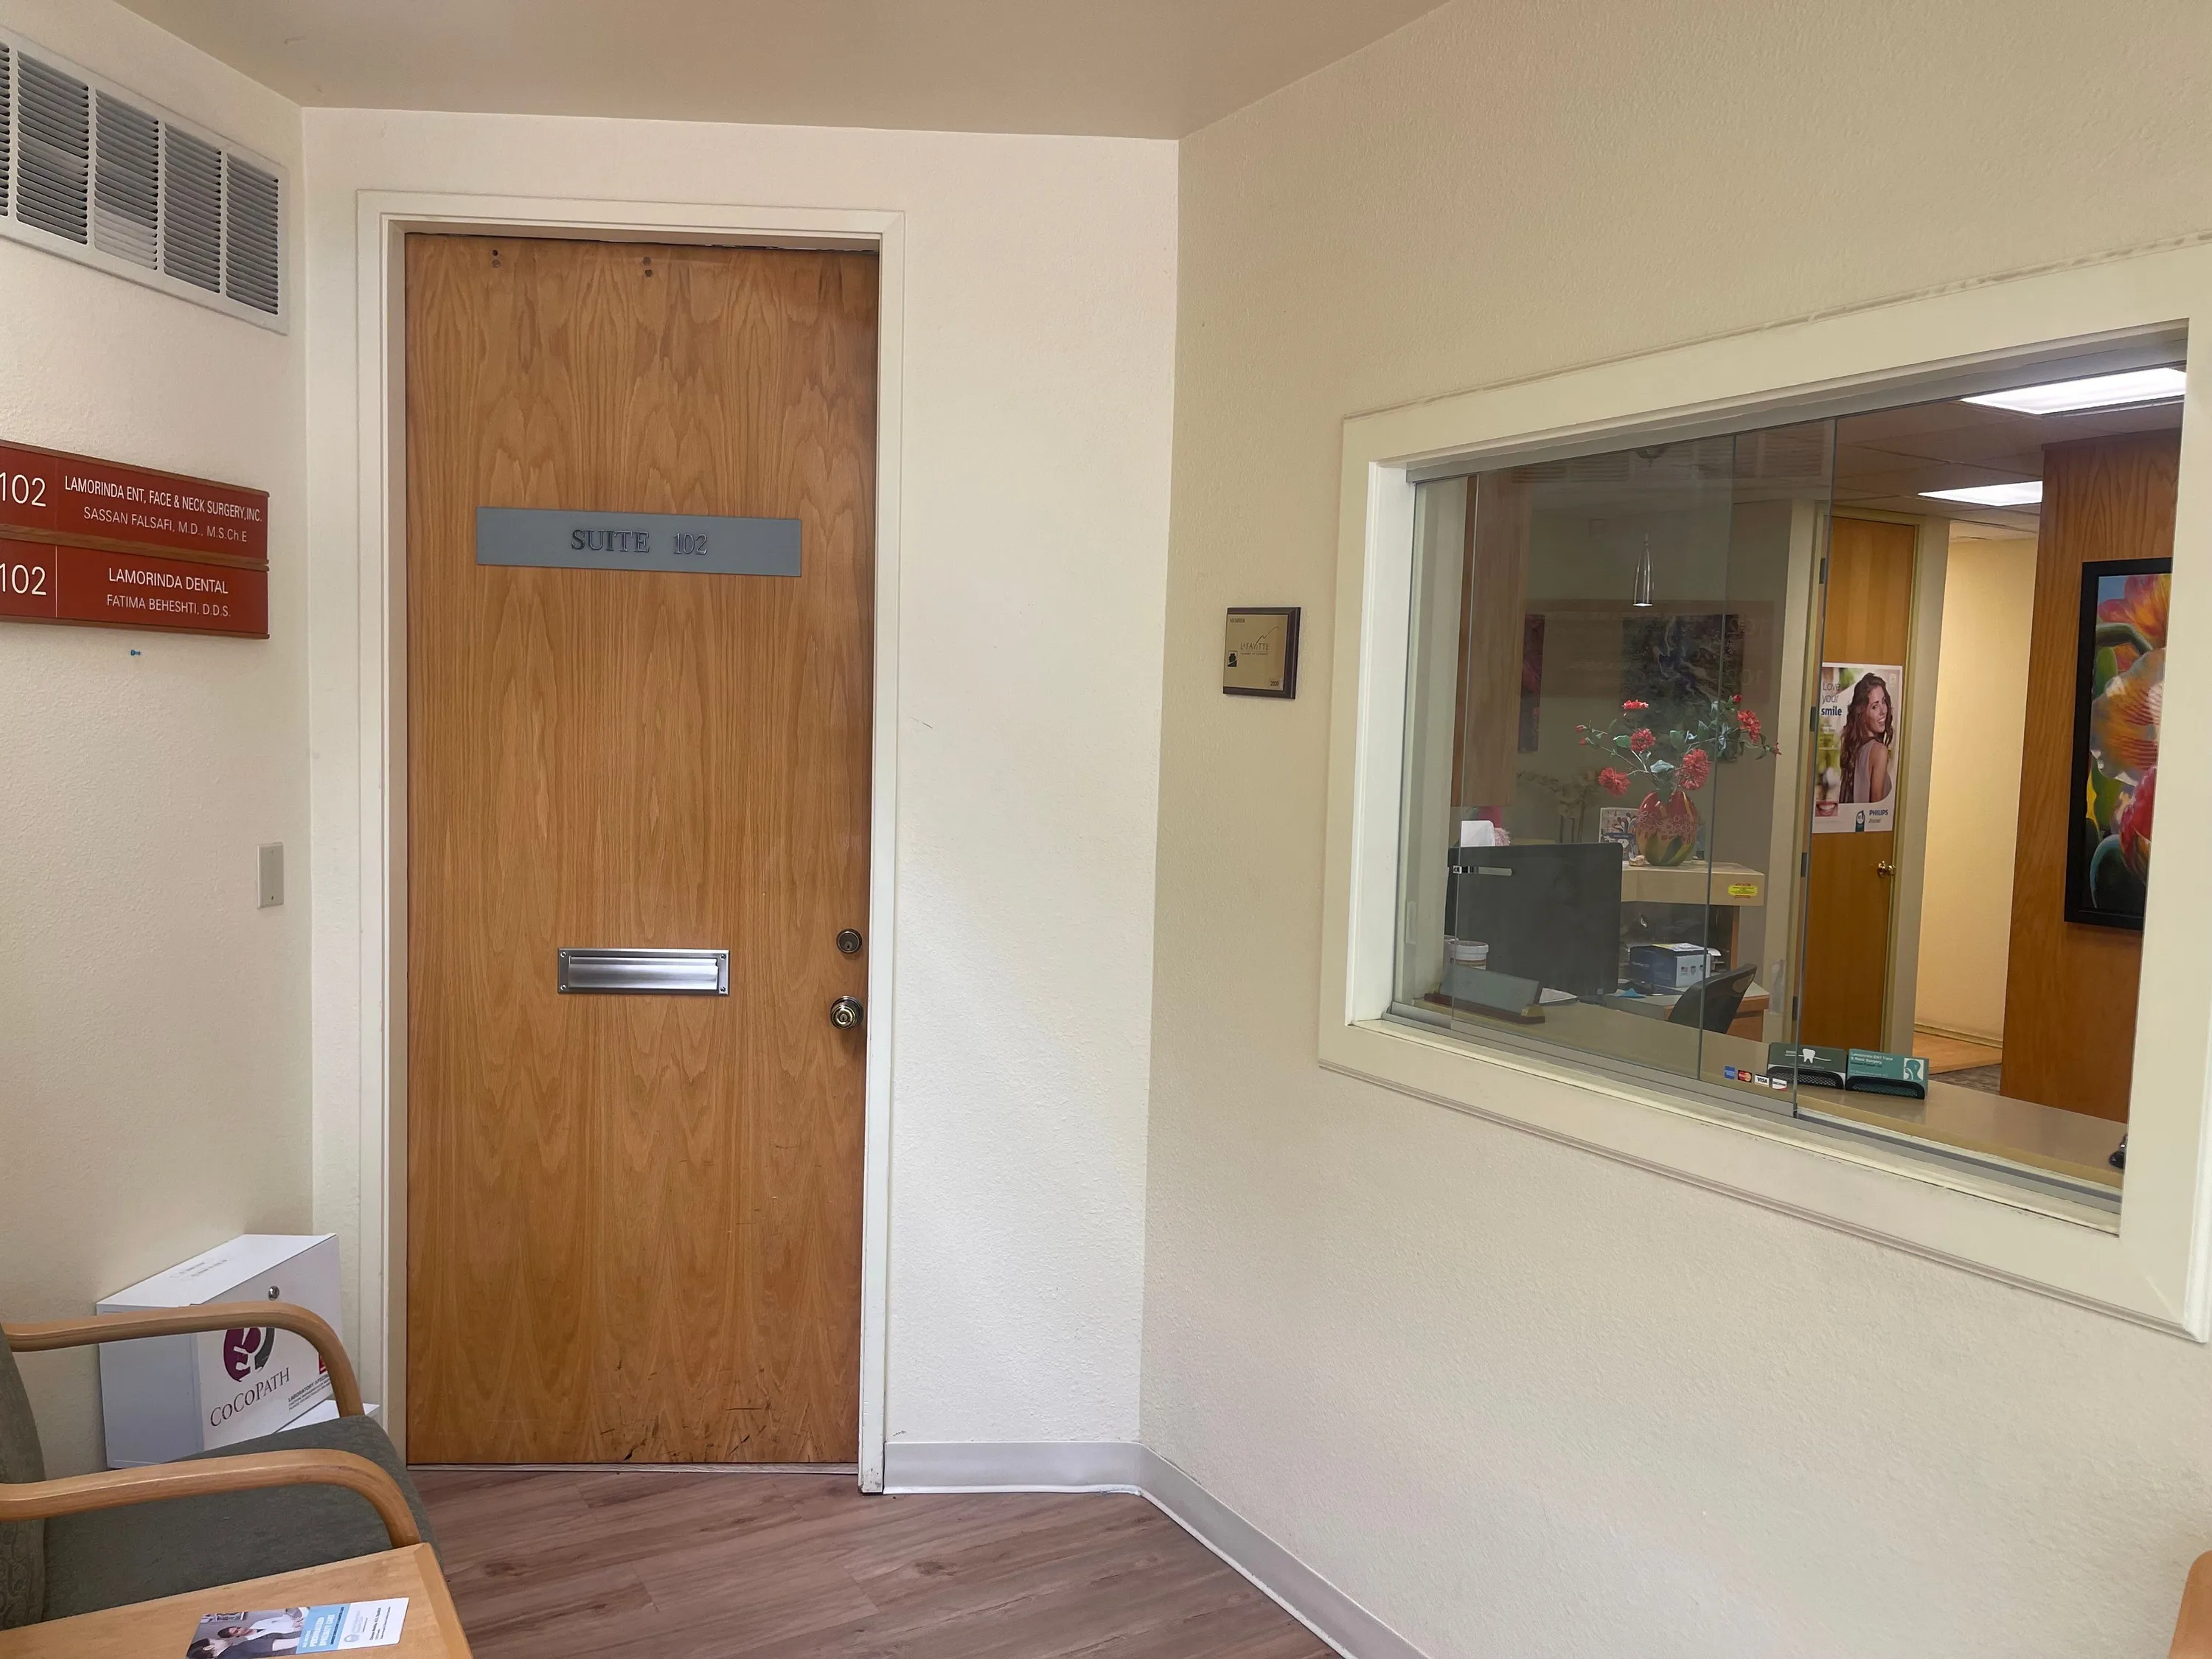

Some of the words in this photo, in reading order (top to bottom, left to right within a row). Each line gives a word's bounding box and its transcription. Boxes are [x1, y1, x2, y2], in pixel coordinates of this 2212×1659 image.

[0, 472, 46, 507] 102
[65, 476, 125, 498] LAMORINDA
[127, 487, 147, 504] ENT,
[149, 490, 172, 507] FACE
[174, 496, 180, 508] &
[182, 496, 205, 512] NECK
[84, 507, 128, 525] SASSAN
[131, 514, 175, 533] FALSAFI,
[571, 528, 650, 553] SUITE
[672, 532, 708, 555] 102
[0, 563, 46, 595] 102
[109, 567, 183, 589] LAMORINDA
[186, 577, 229, 594] DENTAL
[107, 594, 146, 610] FATIMA
[149, 598, 199, 615] BEHESHTI,
[203, 603, 231, 617] D.D.S.
[1823, 681, 1841, 691] Love
[1821, 706, 1842, 715] smile
[1822, 695, 1839, 704] your
[288, 1382, 314, 1402] LABORATORY
